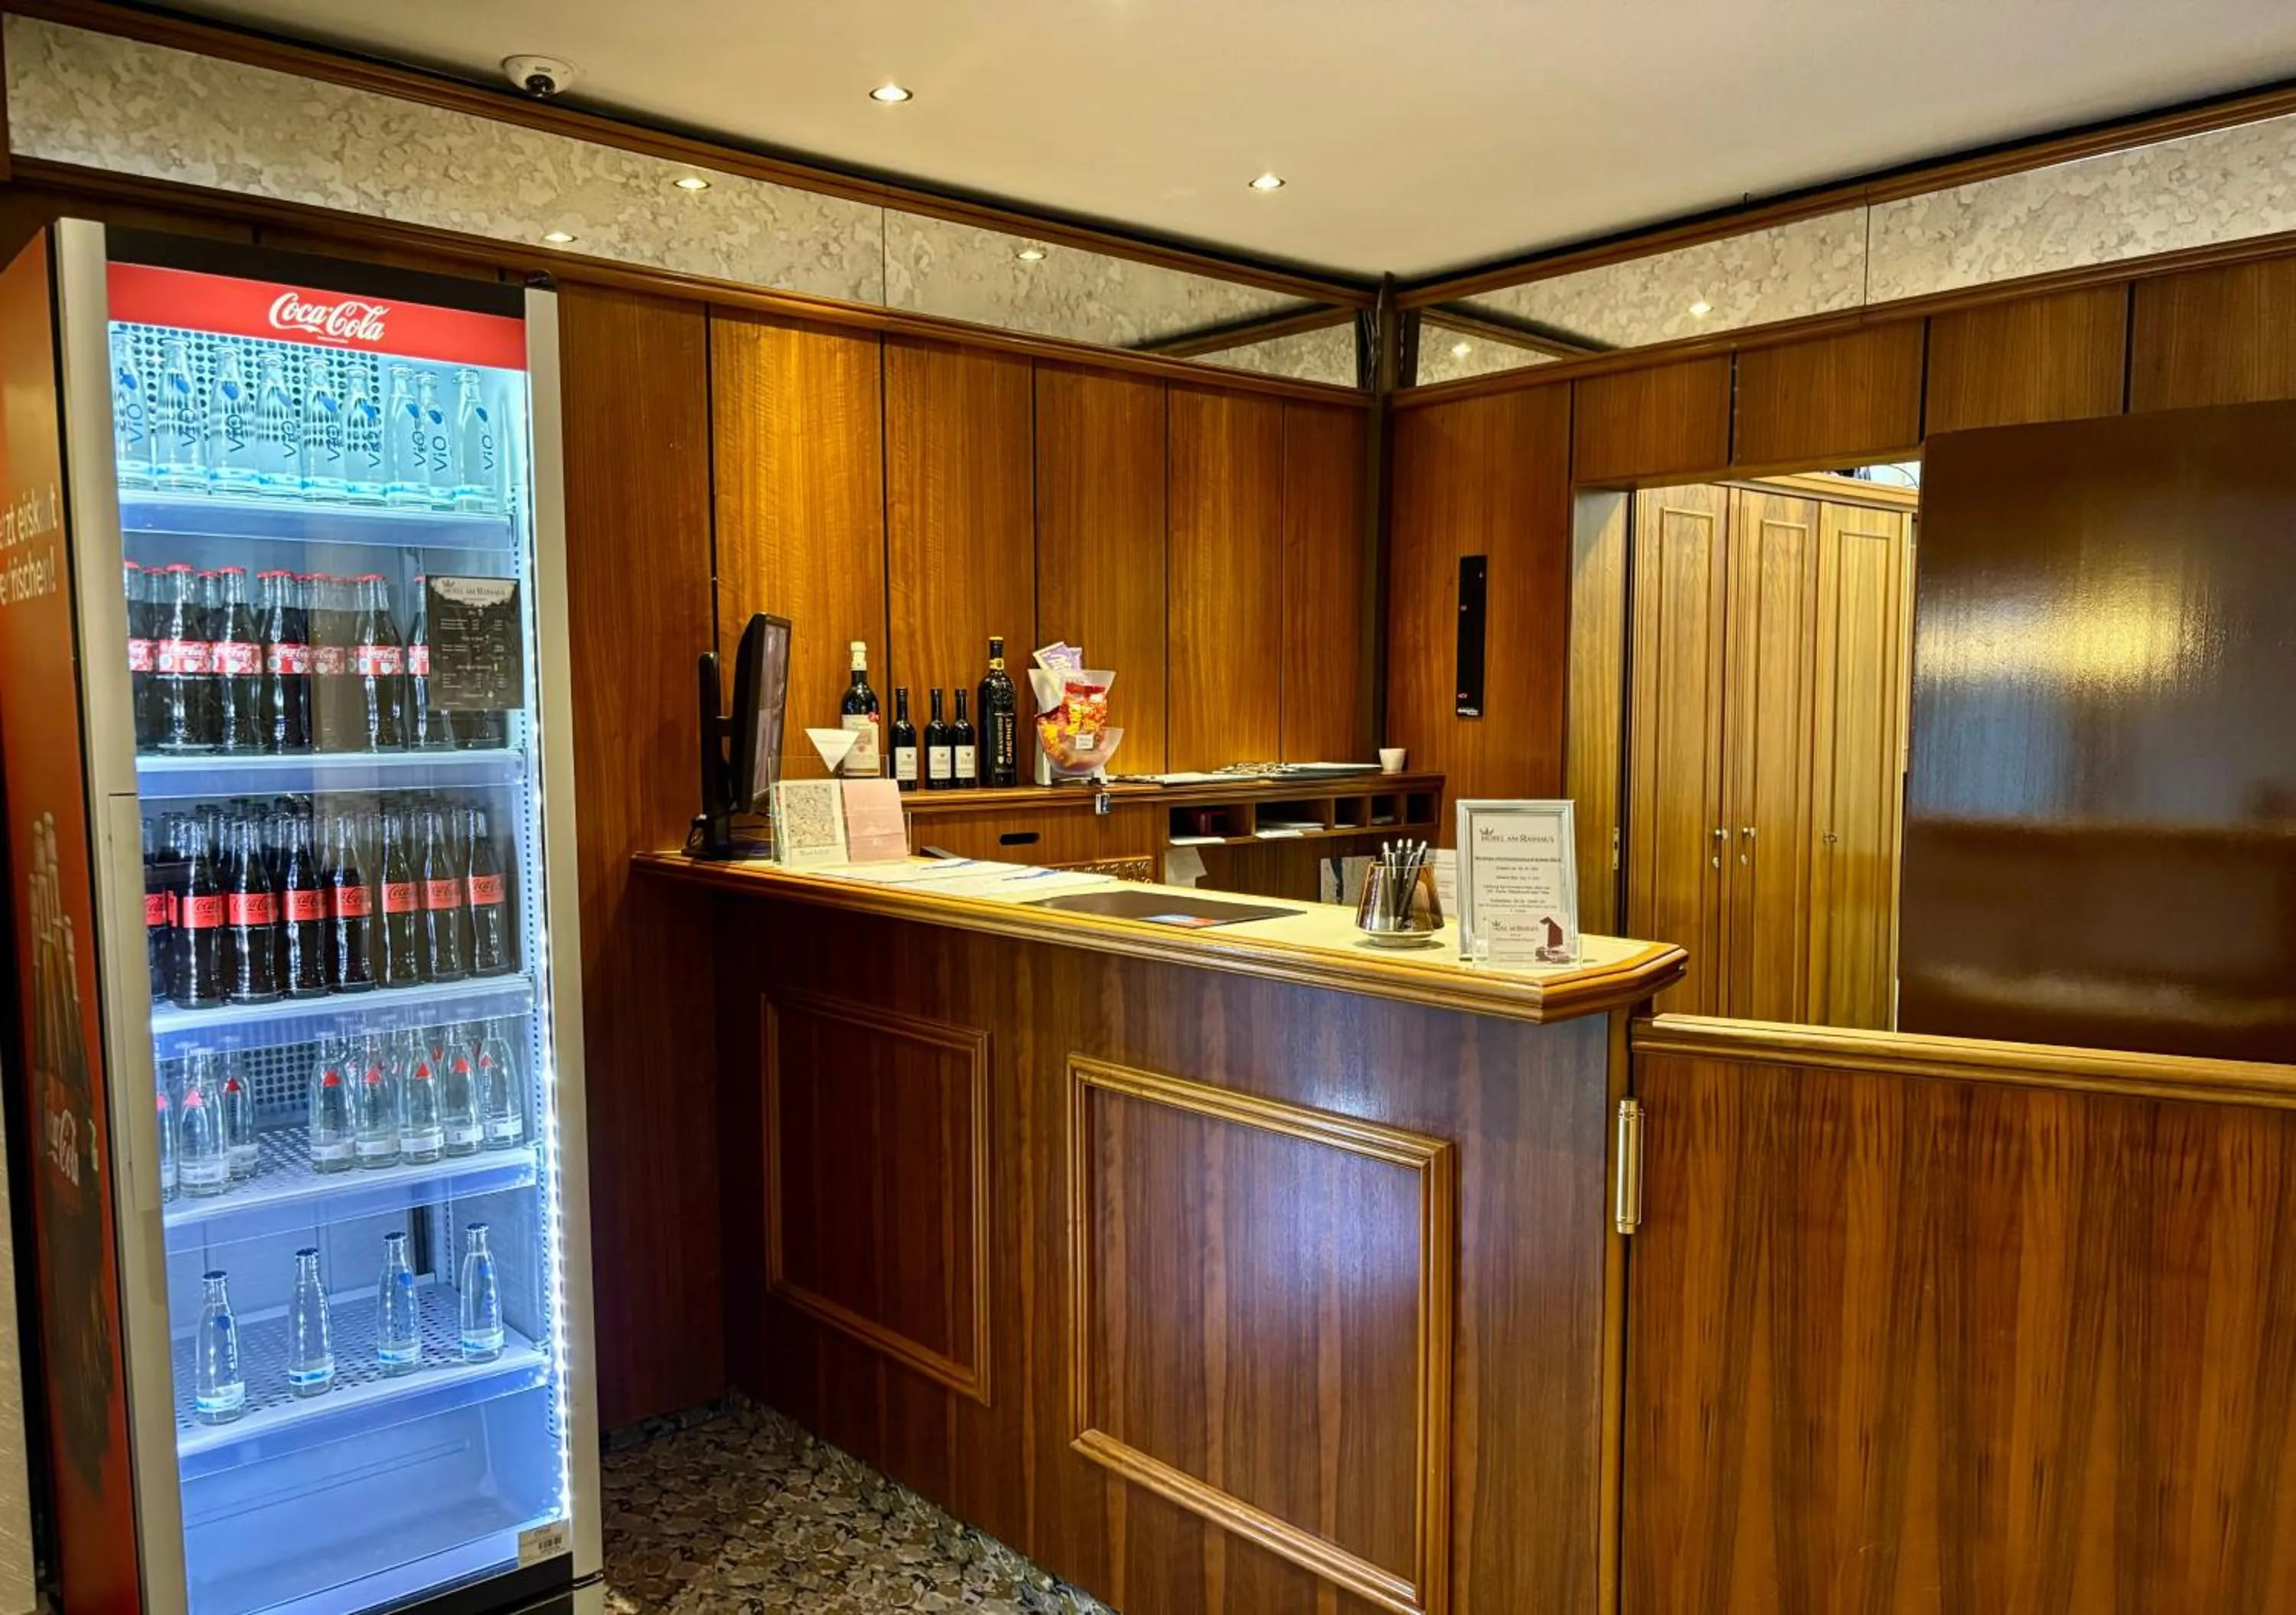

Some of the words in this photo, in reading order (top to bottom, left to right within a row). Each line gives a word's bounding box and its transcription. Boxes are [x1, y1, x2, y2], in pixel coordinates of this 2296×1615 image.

[269, 292, 390, 341] Coca-Cola
[432, 436, 448, 471] ViO
[482, 435, 494, 470] ViO
[18, 482, 58, 541] eiskt
